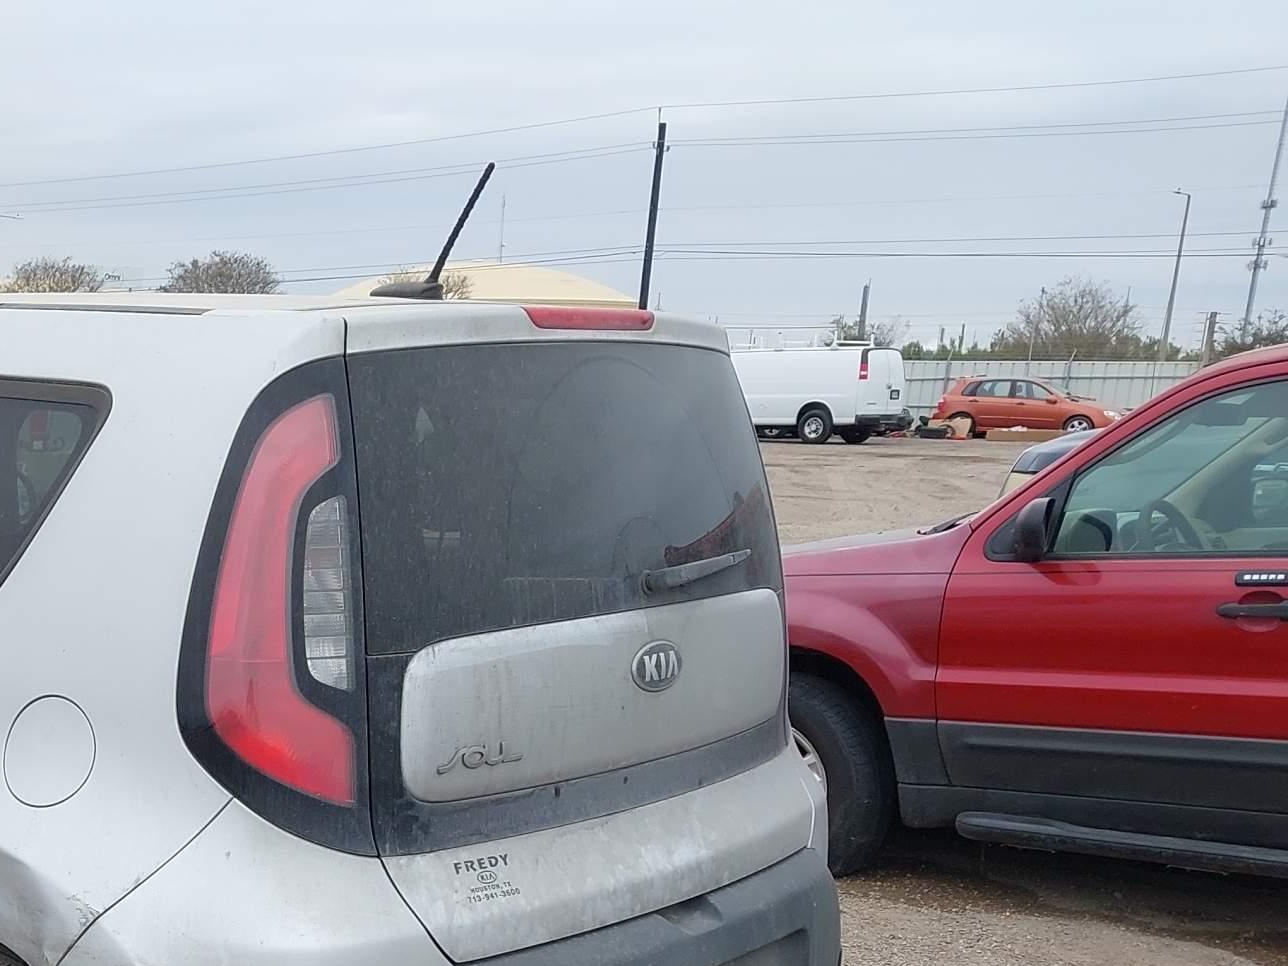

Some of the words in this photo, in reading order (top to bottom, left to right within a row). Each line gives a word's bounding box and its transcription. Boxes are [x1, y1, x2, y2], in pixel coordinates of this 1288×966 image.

[643, 649, 679, 682] KIA
[453, 853, 509, 875] FREDY
[480, 873, 495, 881] KIA
